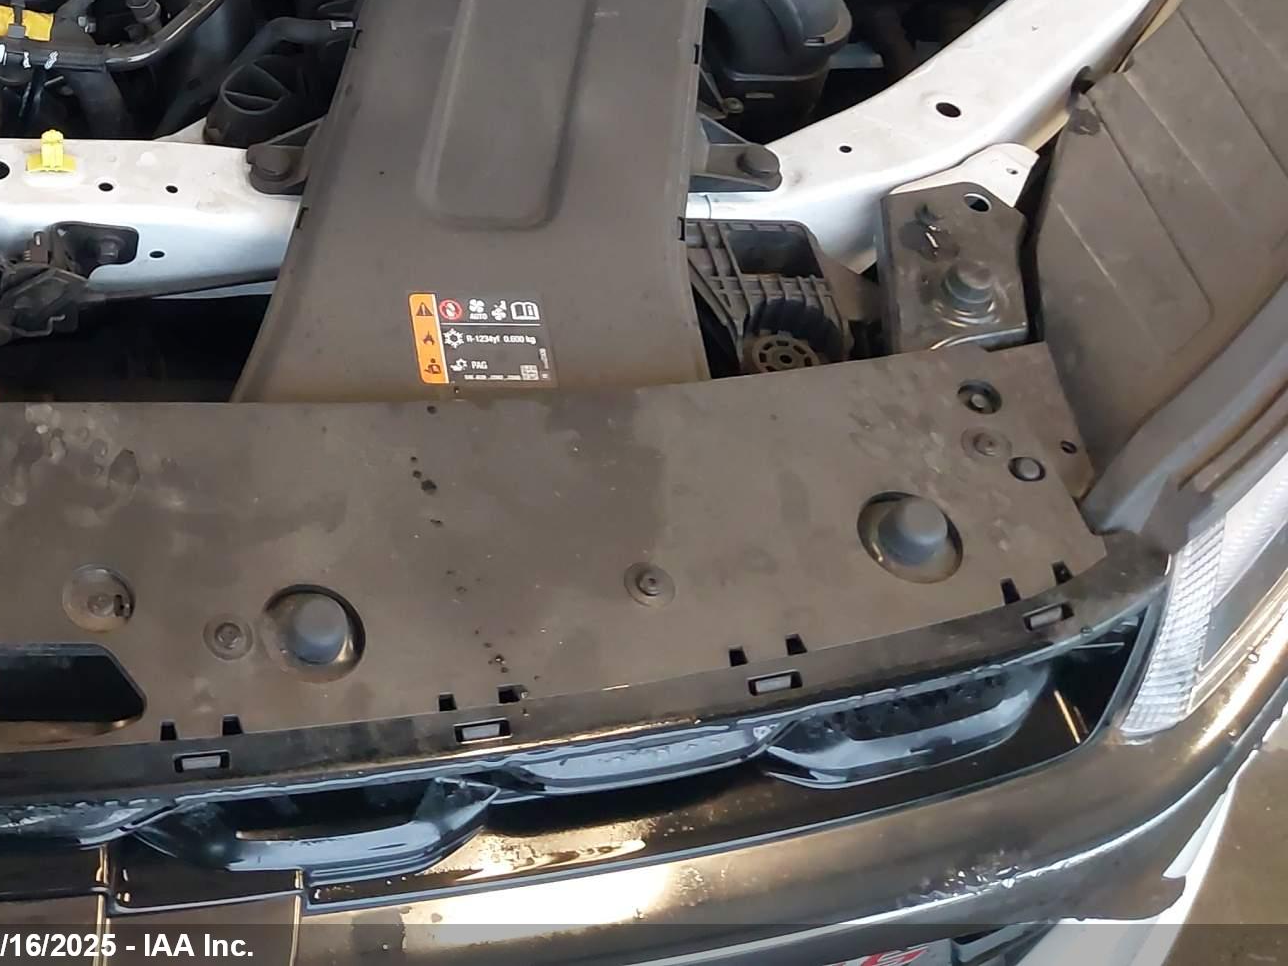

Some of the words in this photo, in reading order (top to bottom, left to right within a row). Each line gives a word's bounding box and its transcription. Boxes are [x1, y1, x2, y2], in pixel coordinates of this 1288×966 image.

[469, 312, 488, 320] AUTO
[466, 335, 500, 344] R-1234yf
[525, 335, 537, 345] kg
[471, 360, 488, 370] PAG
